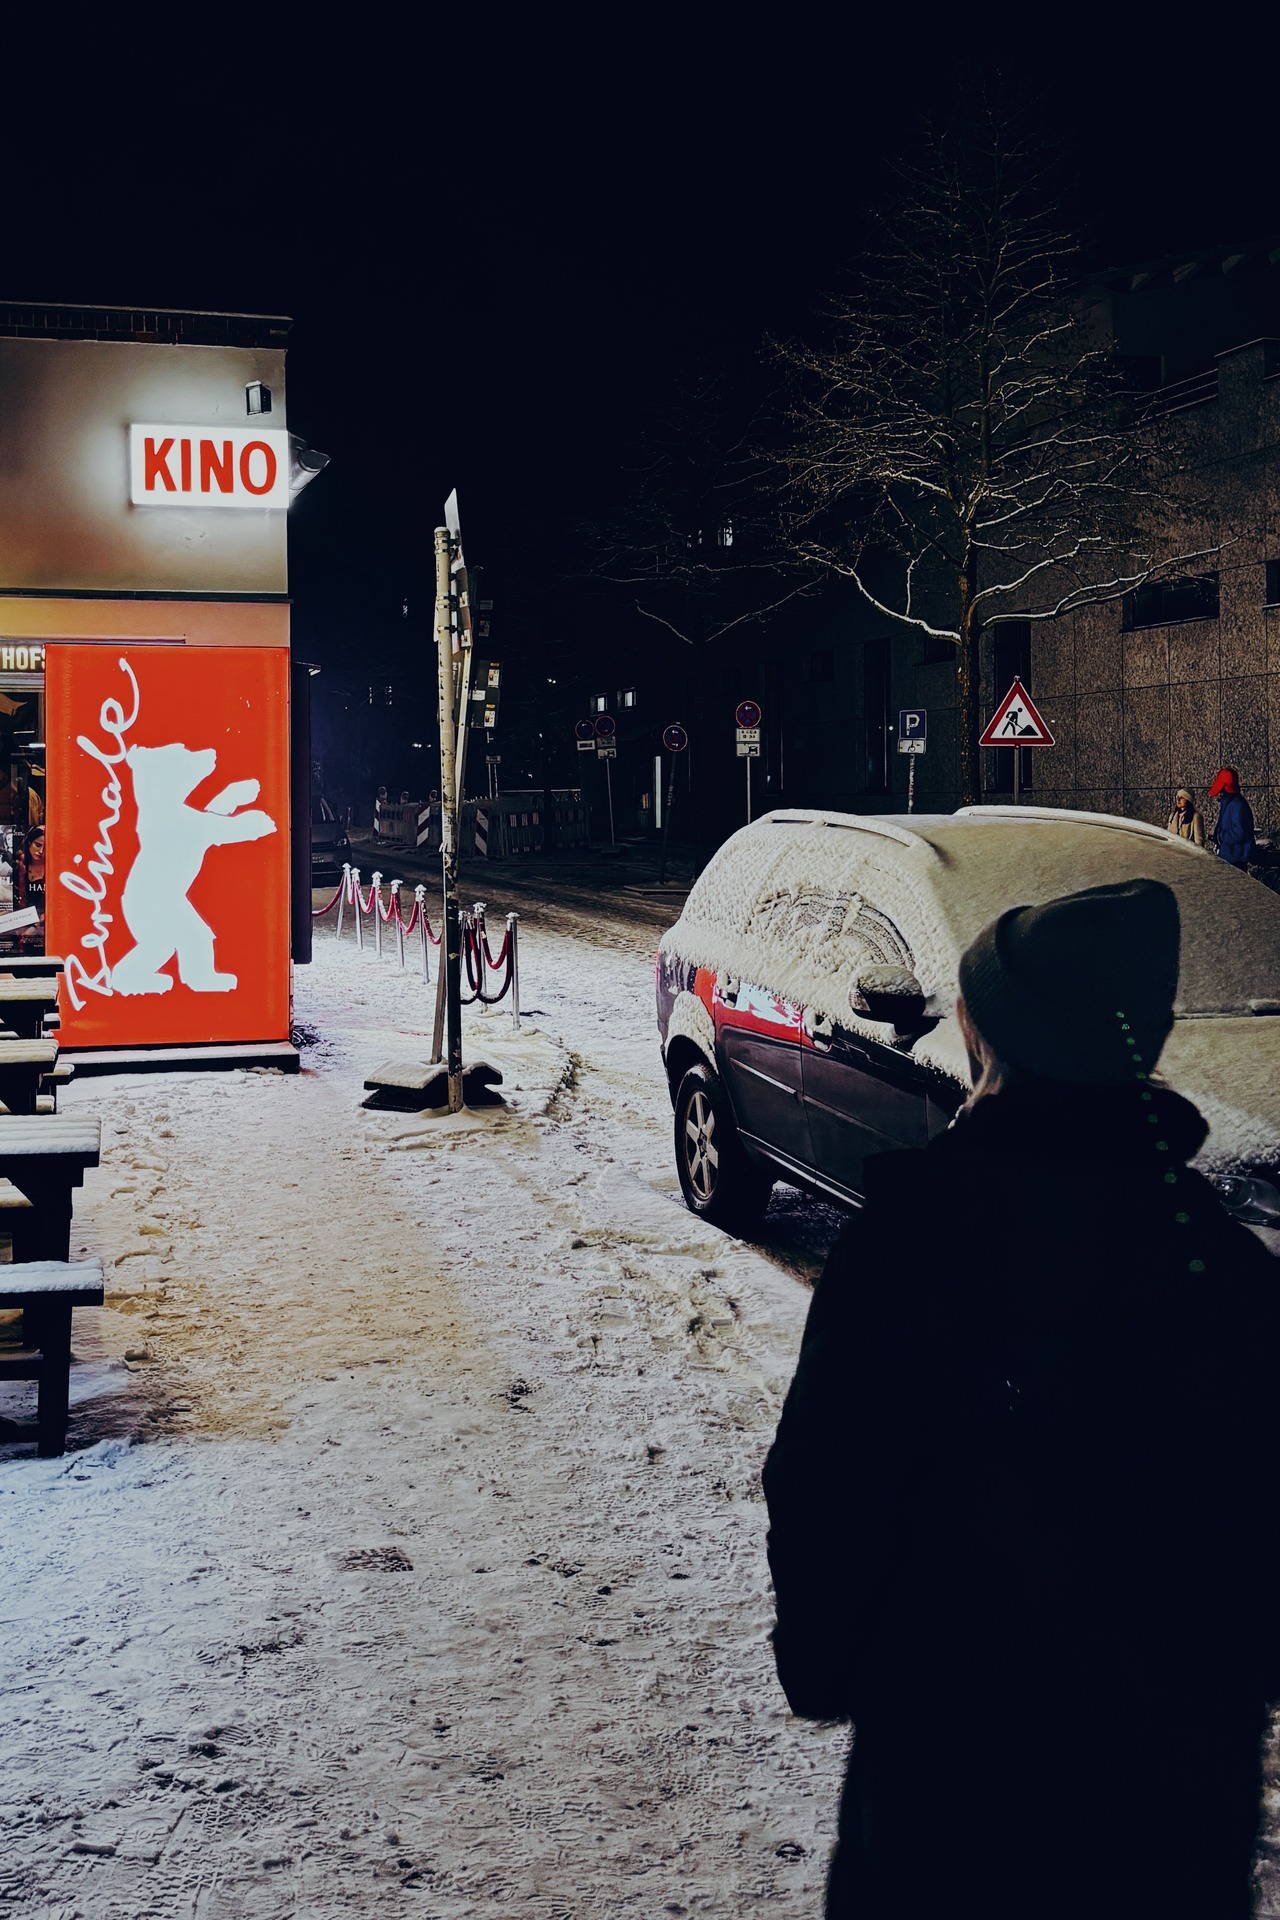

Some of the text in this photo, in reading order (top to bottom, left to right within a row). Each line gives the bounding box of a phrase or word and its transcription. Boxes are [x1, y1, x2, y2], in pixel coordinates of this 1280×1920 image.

[144, 437, 277, 495] KINO
[906, 714, 920, 736] P
[59, 657, 140, 1012] Berlinale
